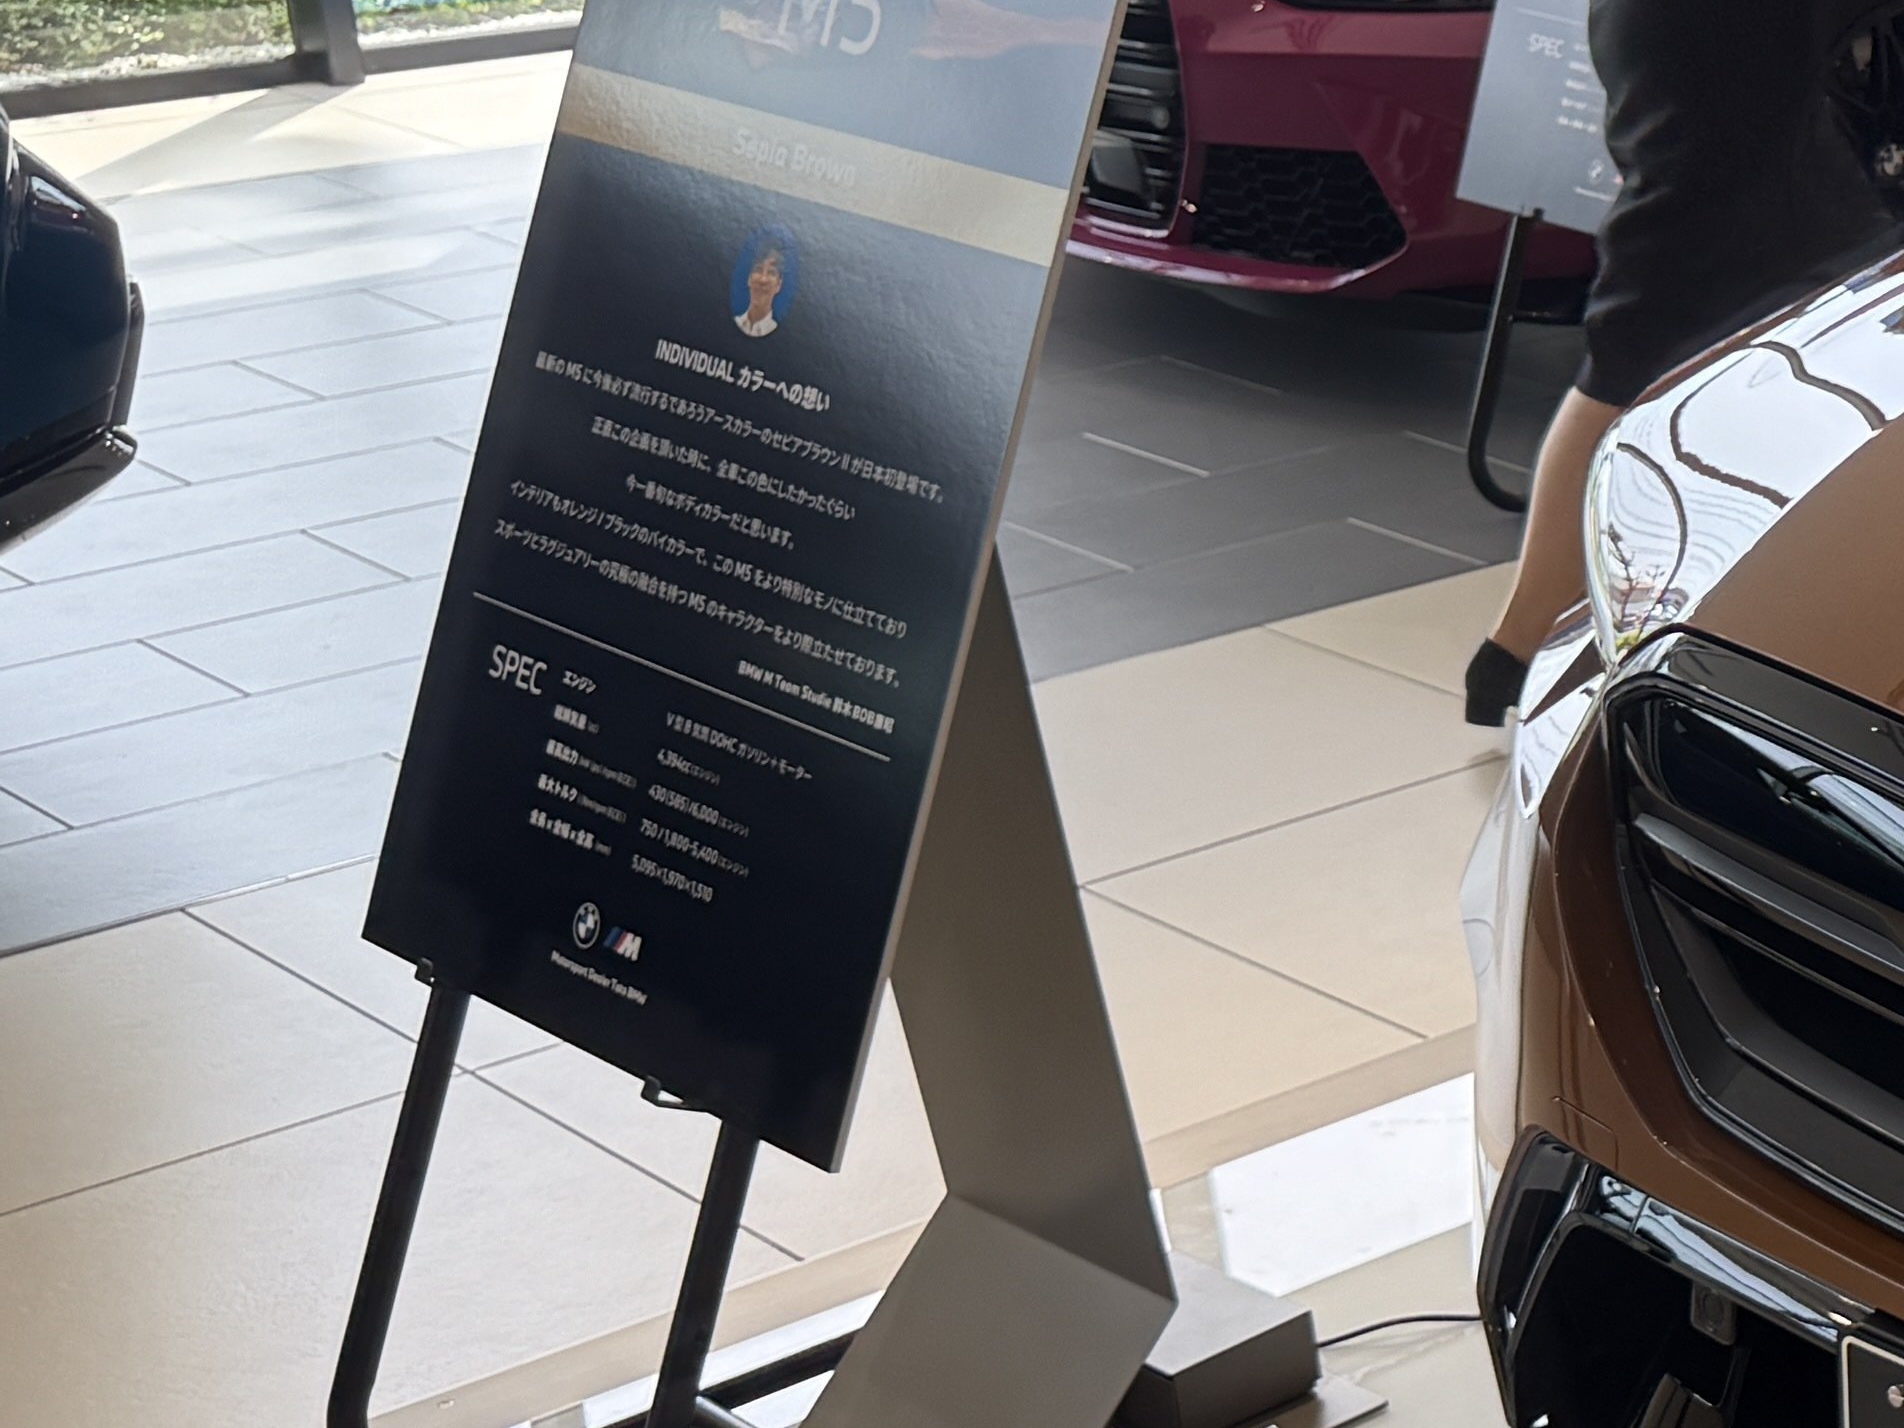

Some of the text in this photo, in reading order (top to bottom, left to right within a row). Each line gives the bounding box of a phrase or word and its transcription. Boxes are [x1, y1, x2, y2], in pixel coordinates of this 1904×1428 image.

[789, 141, 859, 186] Brown
[655, 339, 734, 382] INDIVIDUAL
[488, 644, 547, 695] SPEC
[562, 670, 596, 693] エンジン
